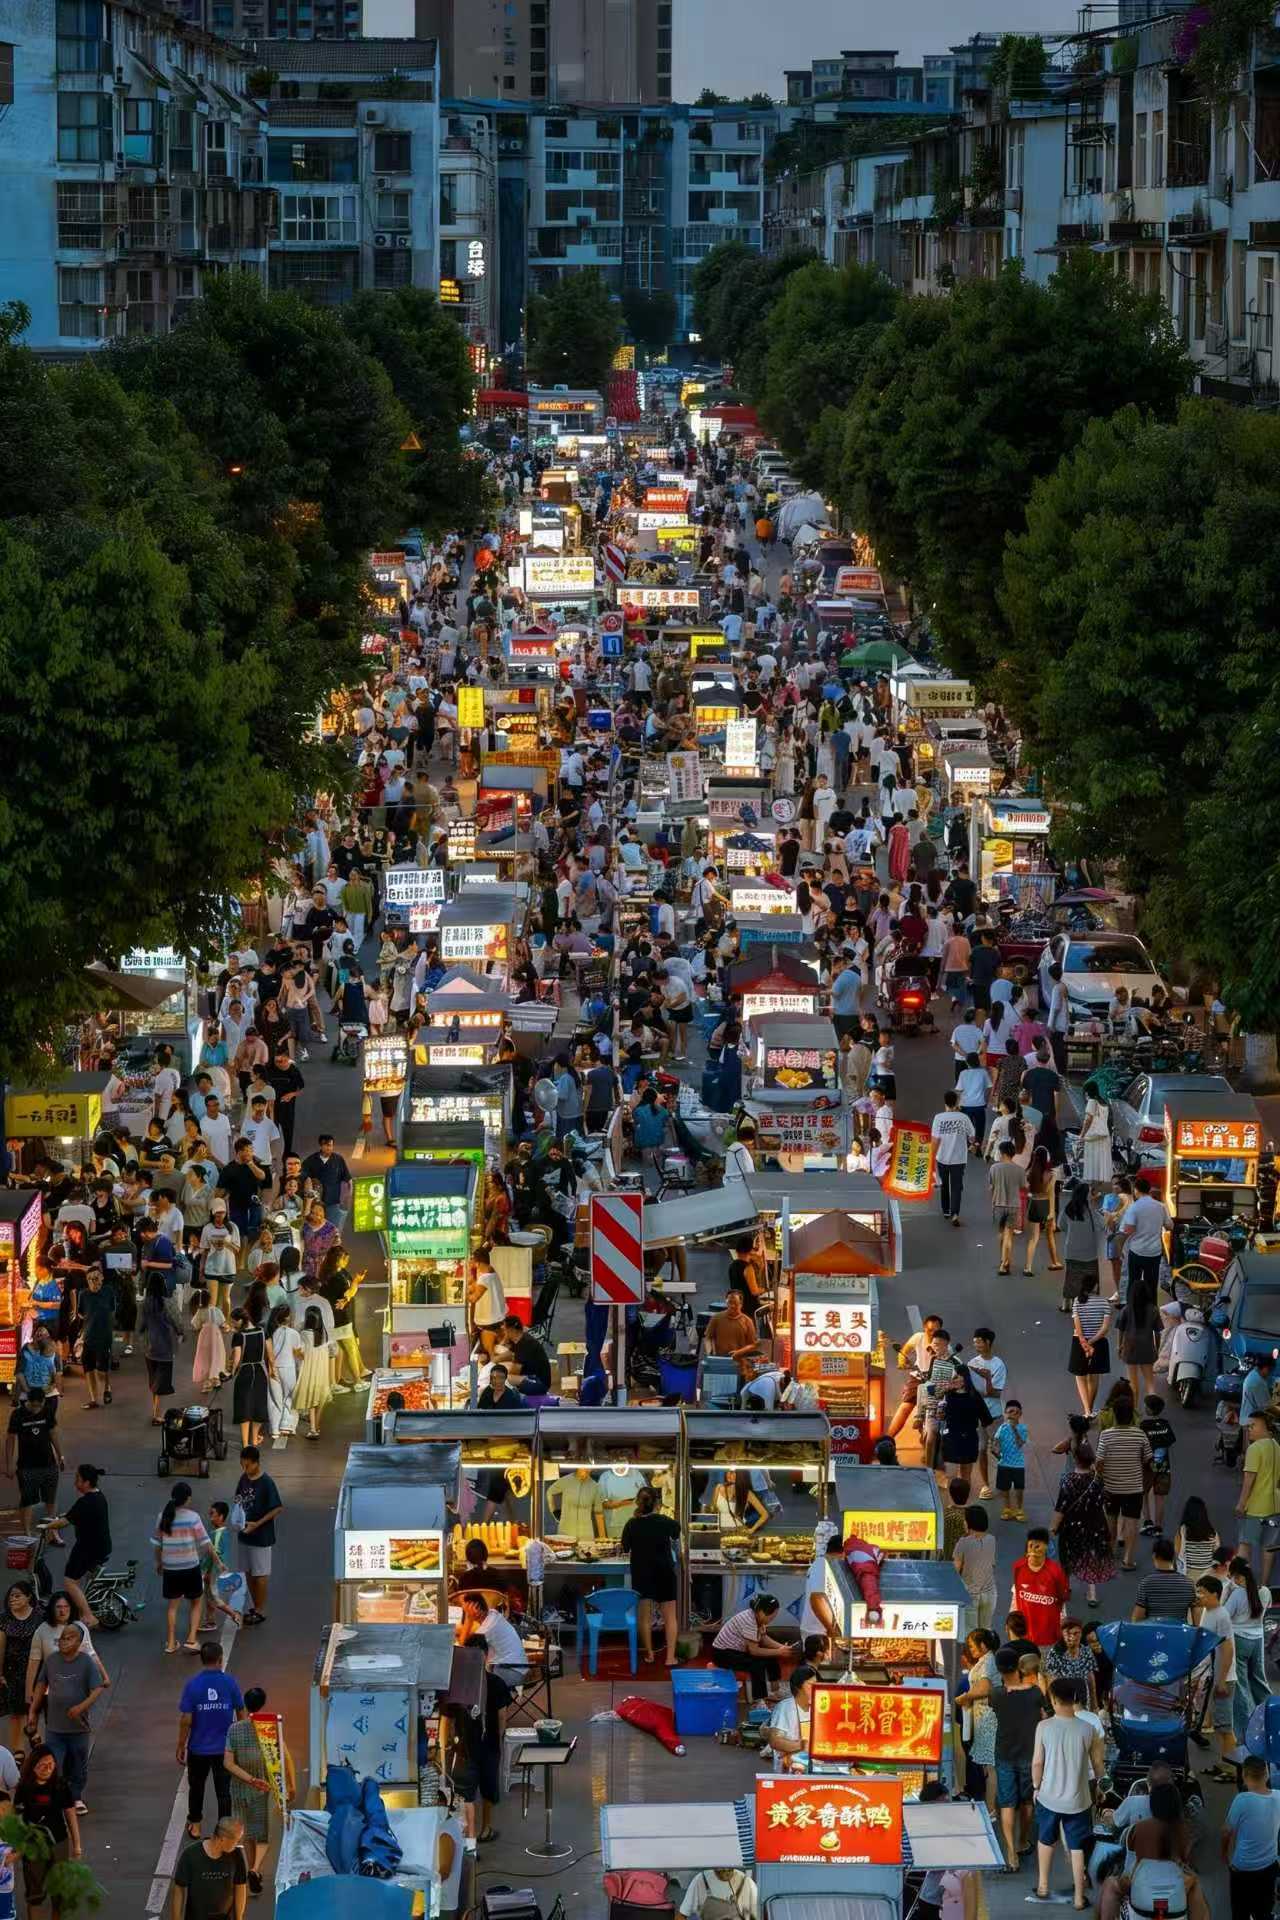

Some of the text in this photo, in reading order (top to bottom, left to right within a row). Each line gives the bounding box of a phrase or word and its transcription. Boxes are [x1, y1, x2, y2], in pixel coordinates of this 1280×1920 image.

[766, 1801, 893, 1831] 黄家香酥鸭
